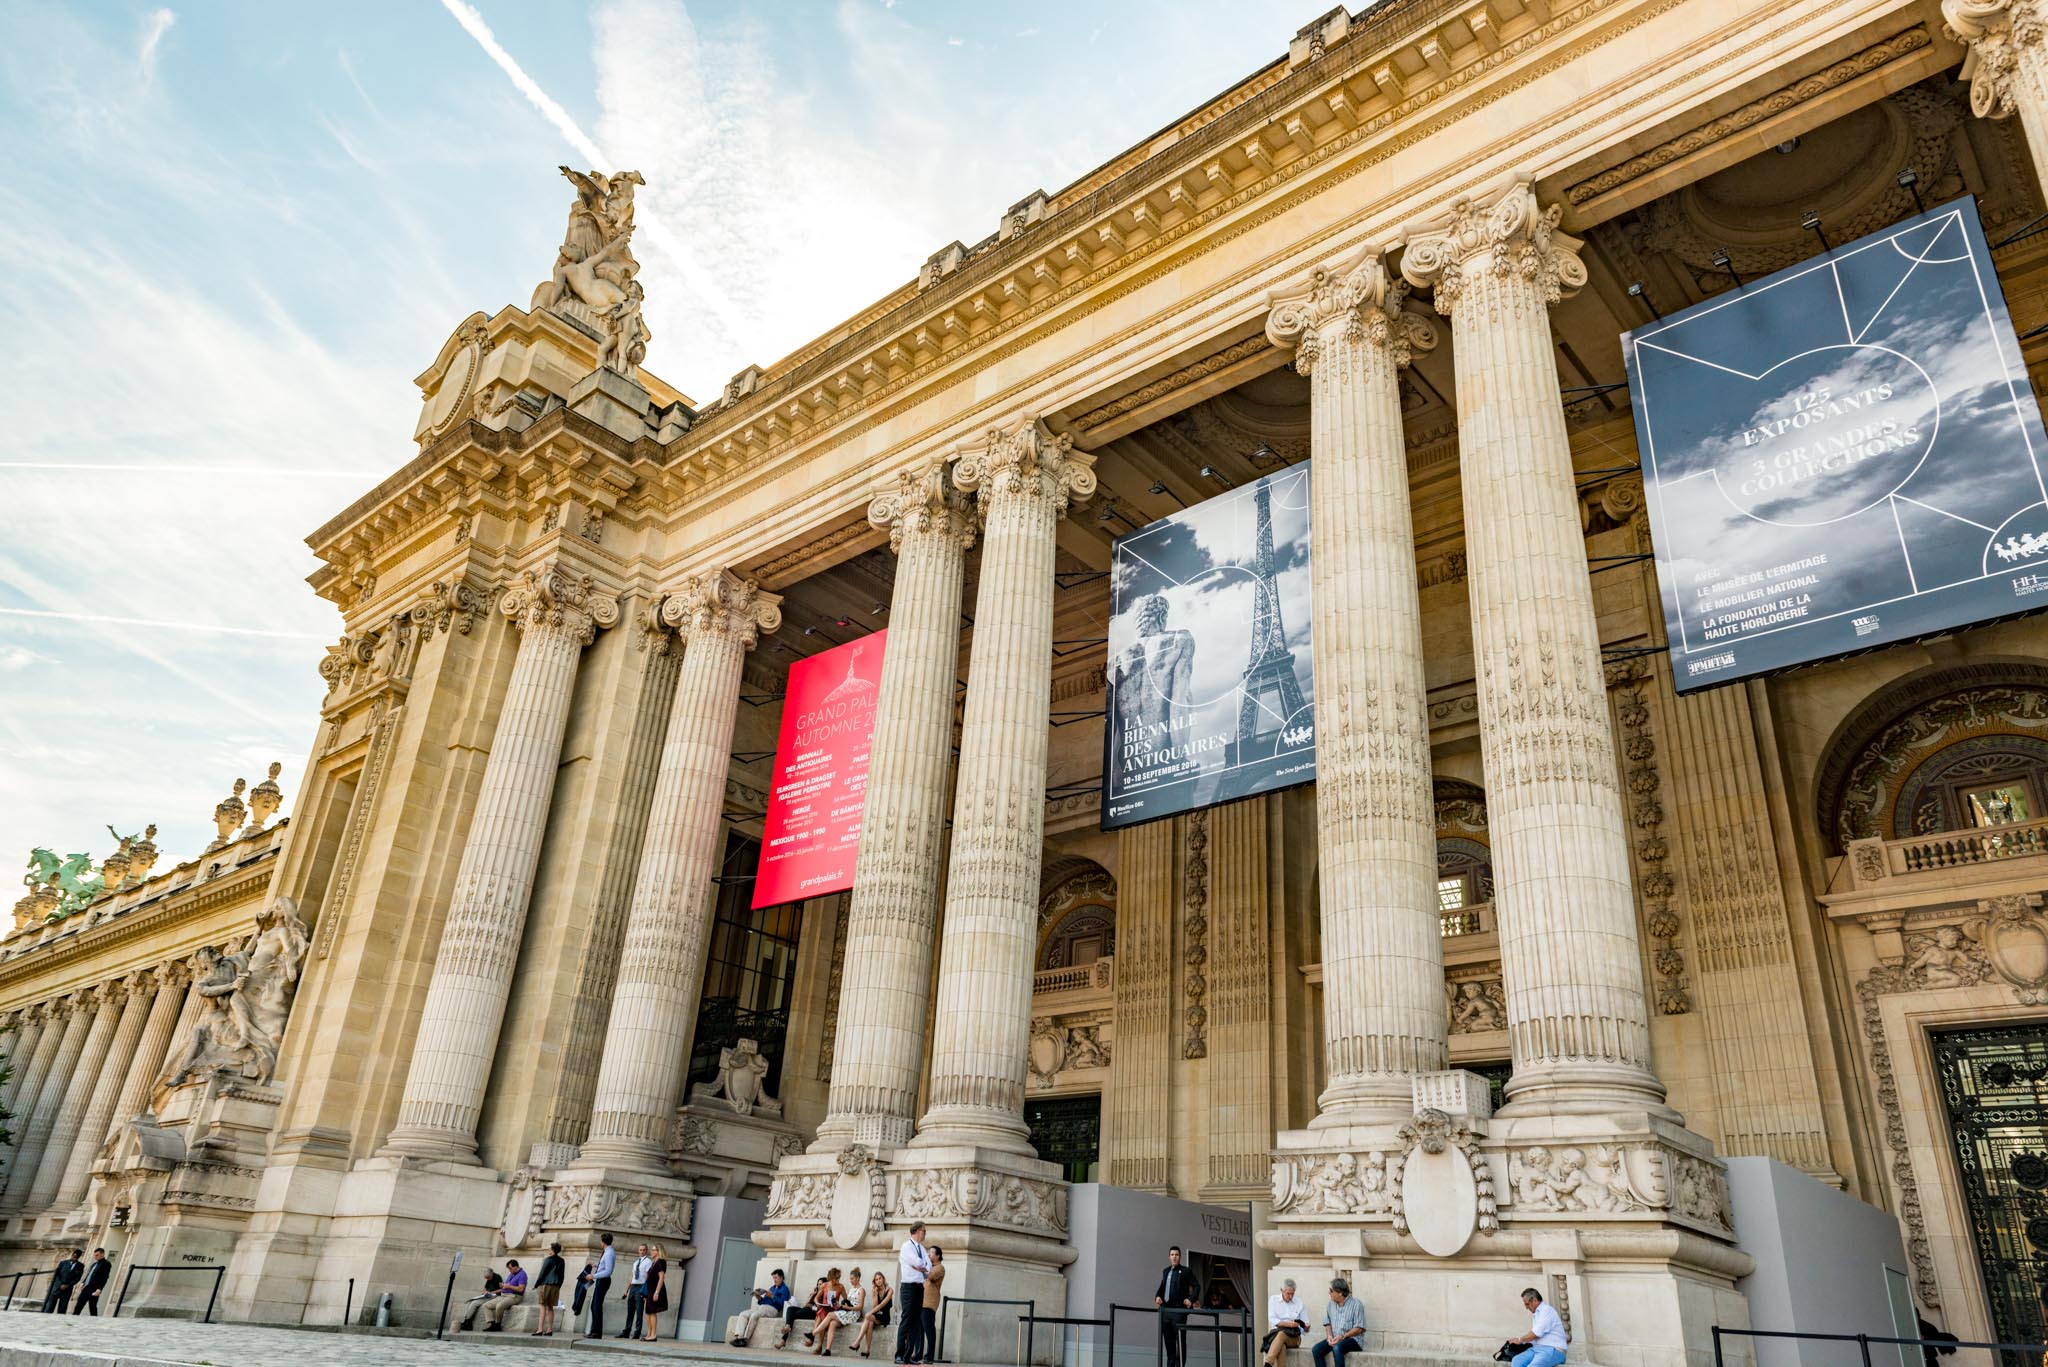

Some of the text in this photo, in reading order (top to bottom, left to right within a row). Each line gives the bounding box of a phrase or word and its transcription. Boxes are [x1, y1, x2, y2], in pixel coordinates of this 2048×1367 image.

[1793, 387, 1831, 412] 125
[1743, 383, 1893, 447] EXPOSANTS
[1774, 417, 1897, 469] GRANDES
[1741, 427, 1921, 496] COLLECTIONS
[1753, 459, 1766, 477] 3
[1697, 586, 1710, 597] LE
[1749, 571, 1765, 583] DE
[1700, 574, 1820, 613] LE MOBILIER NATIONAL
[1703, 593, 1812, 630] LA FONDATION DE LA
[1704, 605, 1809, 640] HAUTE HORLOGERIE
[796, 692, 877, 730] GRAND PAL
[1124, 714, 1143, 731] LA
[792, 711, 878, 750] AUTOMNE 20
[1124, 712, 1199, 745] BIENNALE
[796, 749, 823, 762] BIENNALE
[1123, 739, 1152, 759] DES
[1123, 732, 1227, 774] ANTIQUAIRES
[1142, 763, 1181, 781] SEPTEMBRE
[800, 869, 844, 889] grandpalais.fr
[1201, 1213, 1250, 1236] VESTIAIR
[1211, 1235, 1247, 1249] CLOAKROOM
[182, 1254, 215, 1264] PORTE H
